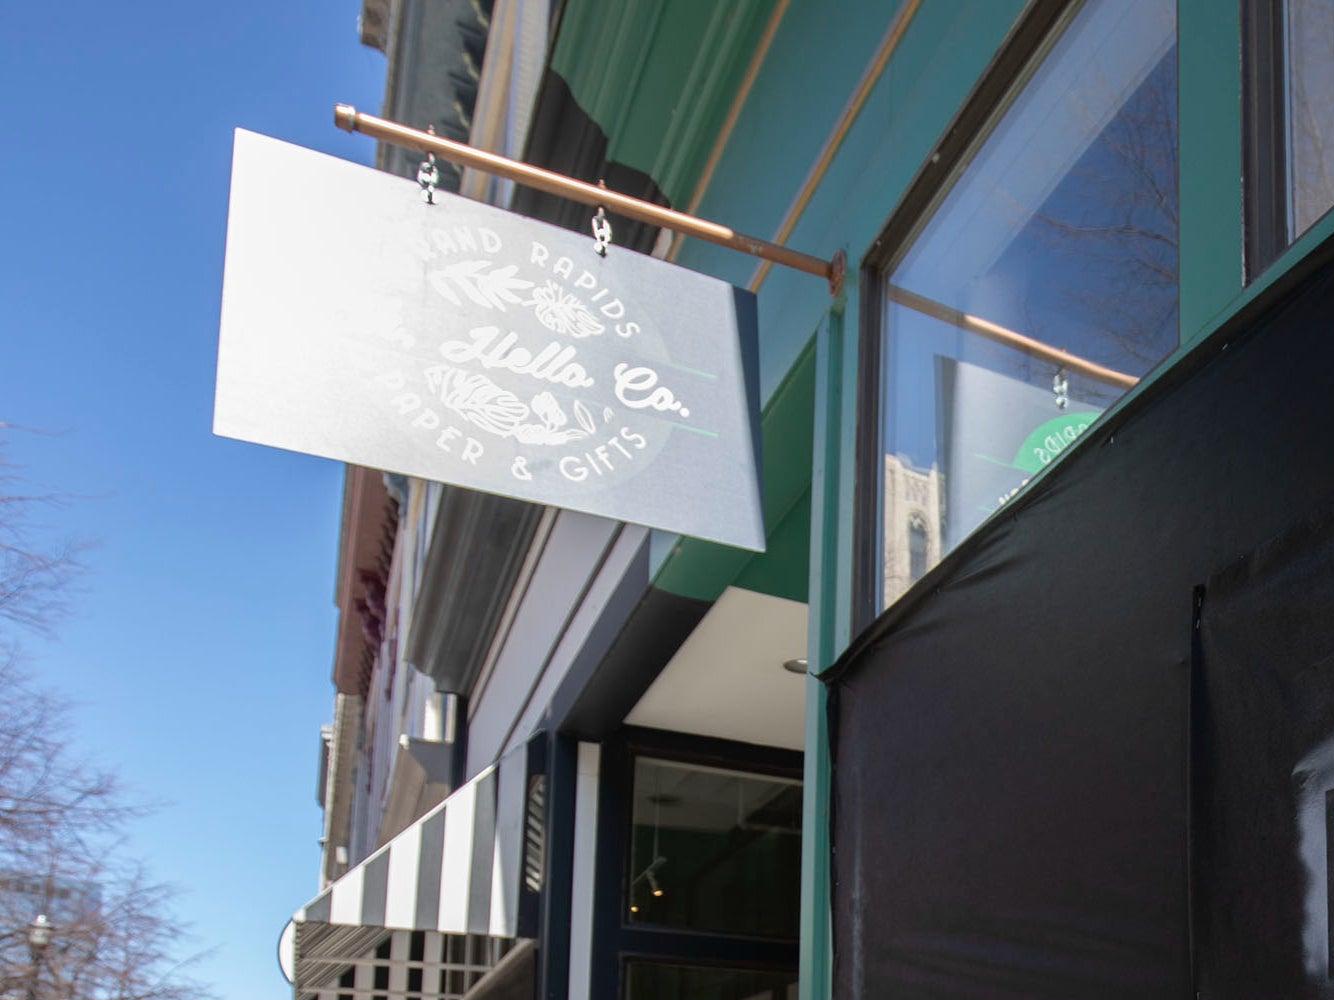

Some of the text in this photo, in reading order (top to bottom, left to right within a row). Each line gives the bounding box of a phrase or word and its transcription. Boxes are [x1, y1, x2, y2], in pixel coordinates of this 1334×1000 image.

[530, 242, 641, 338] RAPIDS
[440, 326, 595, 388] Hello
[614, 362, 690, 418] Co.
[511, 456, 533, 481] &
[559, 427, 646, 483] GIFTS
